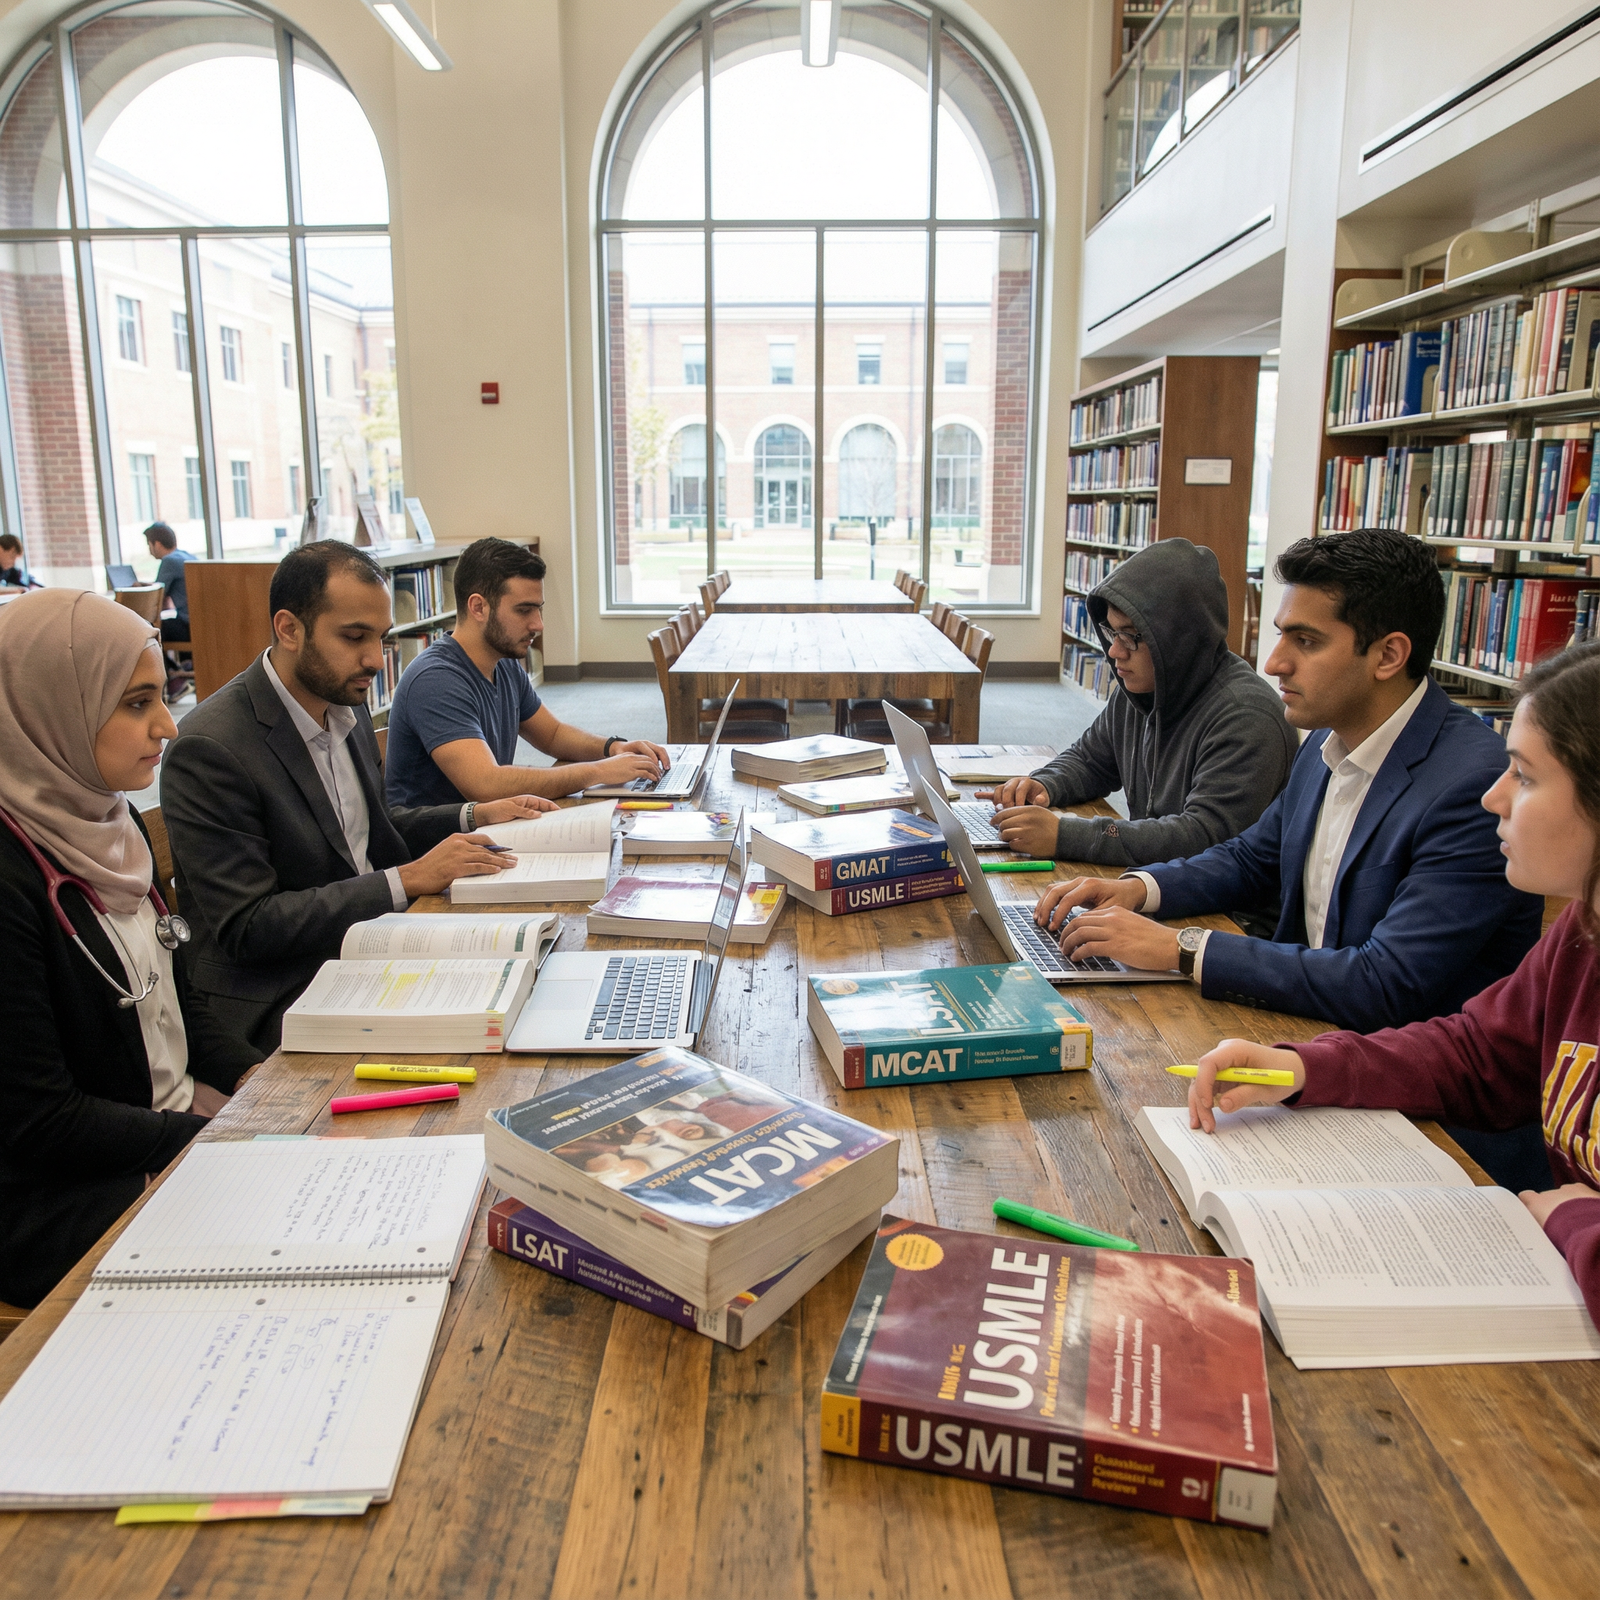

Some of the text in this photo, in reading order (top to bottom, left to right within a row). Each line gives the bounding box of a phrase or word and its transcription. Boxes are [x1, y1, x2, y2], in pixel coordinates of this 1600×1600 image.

[836, 856, 890, 880] GMAT
[848, 883, 905, 908] USMLE
[872, 1048, 964, 1079] MCAT
[688, 1122, 843, 1207] MCAT
[511, 1227, 569, 1271] LSAT
[963, 1247, 1050, 1411] USMLE
[895, 1415, 1078, 1489] USMLE
